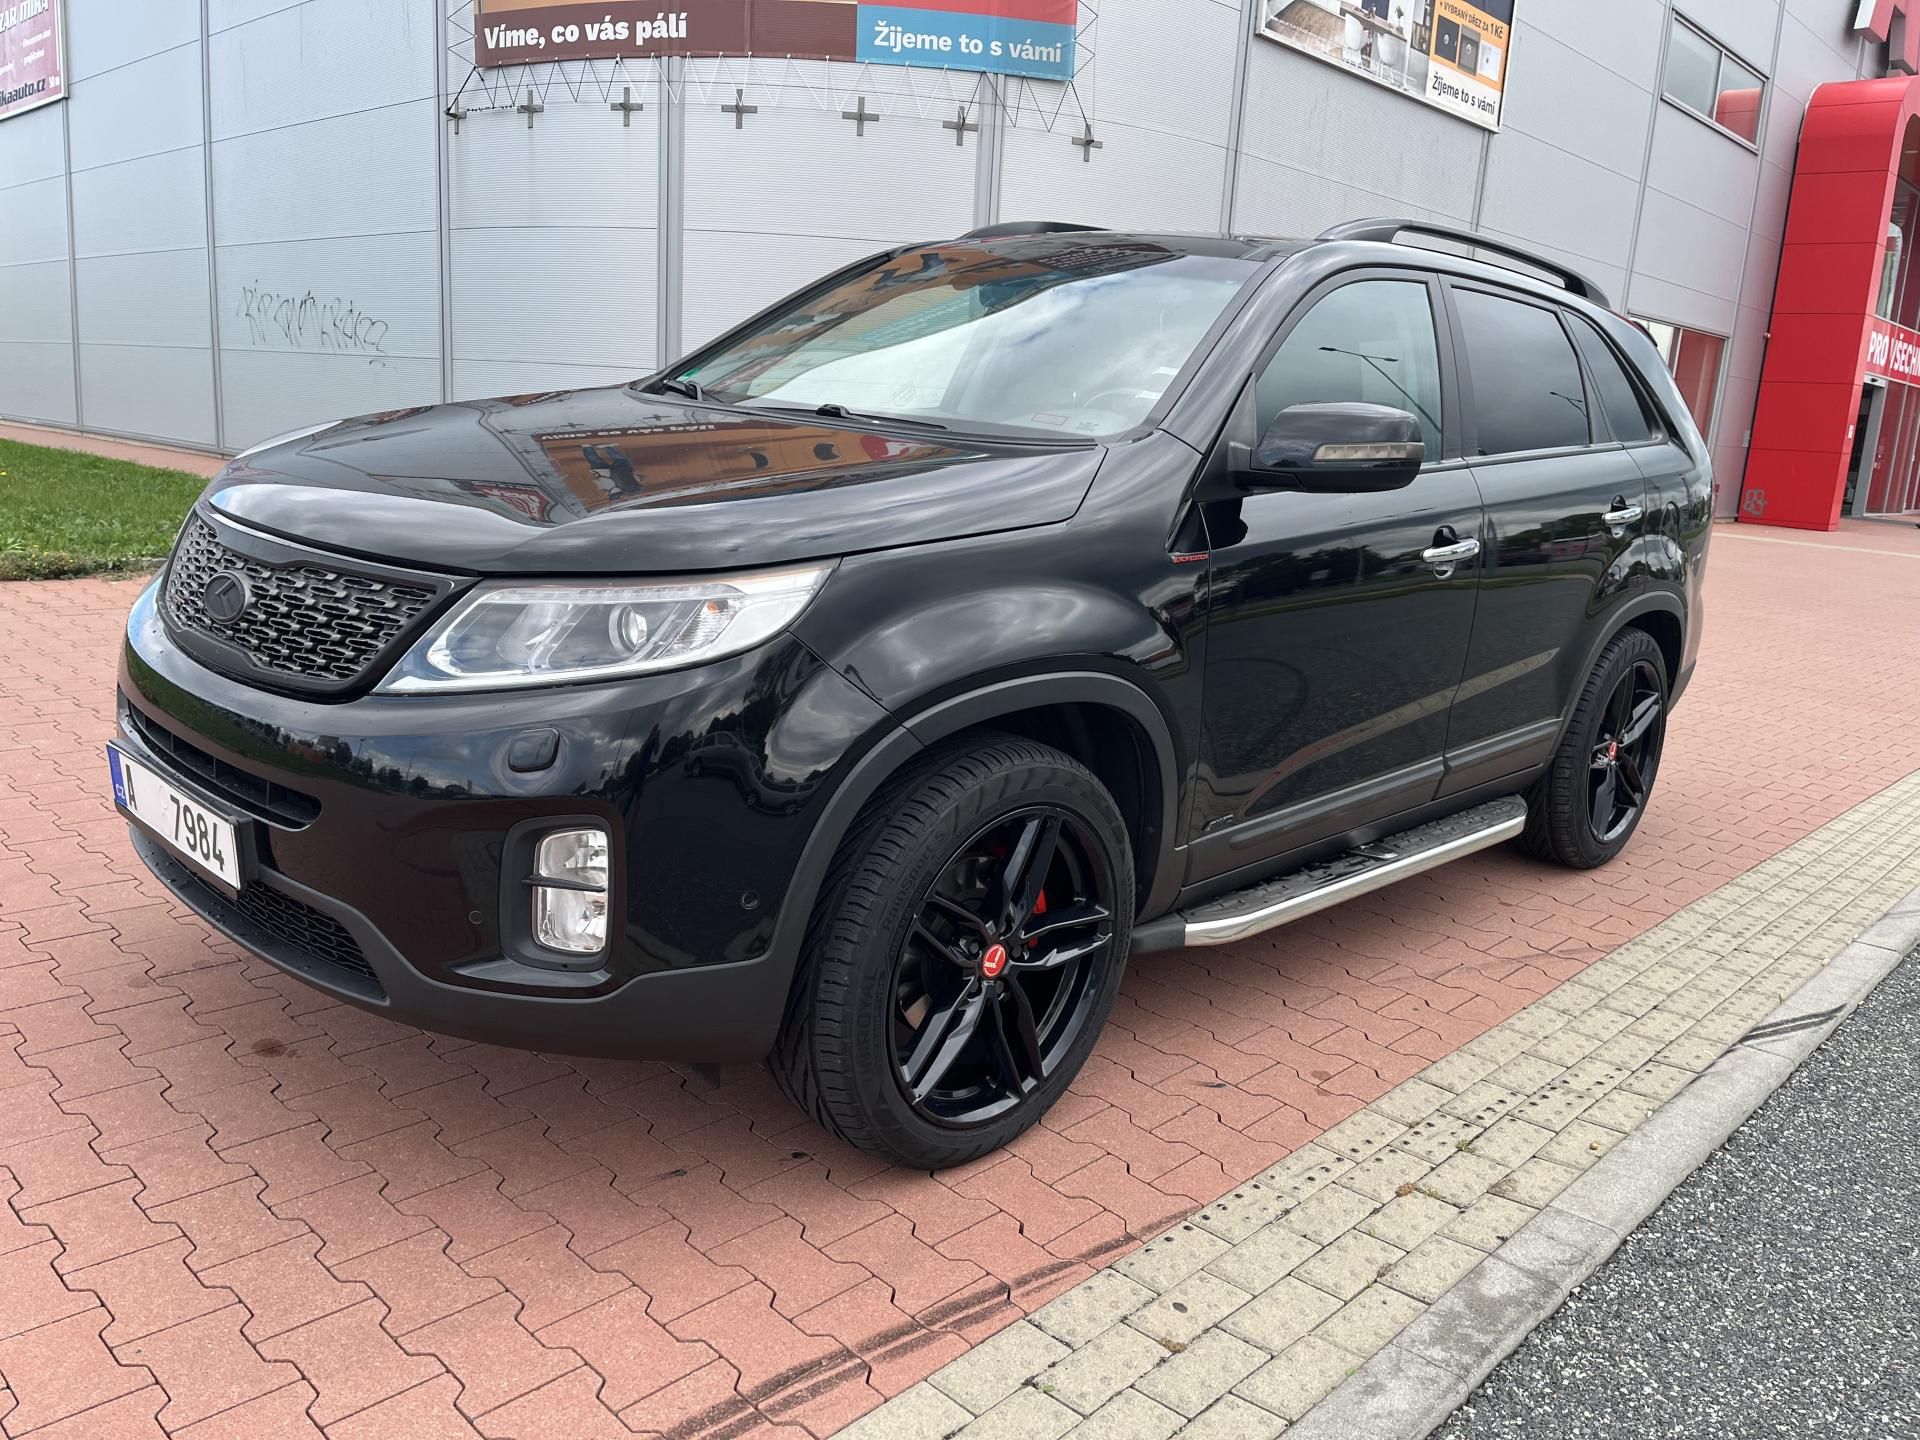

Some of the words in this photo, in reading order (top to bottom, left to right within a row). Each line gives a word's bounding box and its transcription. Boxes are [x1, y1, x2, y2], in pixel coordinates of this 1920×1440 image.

[484, 24, 546, 49] Víme,
[551, 23, 580, 43] co
[584, 15, 629, 41] vás
[635, 12, 688, 46] pálí
[1444, 1, 1468, 20] VYBRANÝ
[1482, 22, 1489, 32] ZA
[874, 20, 952, 52] Žijeme
[958, 34, 984, 54] to
[990, 40, 1002, 56] s
[1008, 38, 1062, 63] vámi
[1432, 72, 1460, 99] Žijeme
[1461, 88, 1470, 104] to
[1470, 95, 1476, 107] s
[1477, 96, 1496, 115] vámi
[1867, 330, 1890, 368] PRO
[116, 783, 126, 799] CZ
[125, 763, 138, 811] A
[169, 793, 225, 873] 7984
